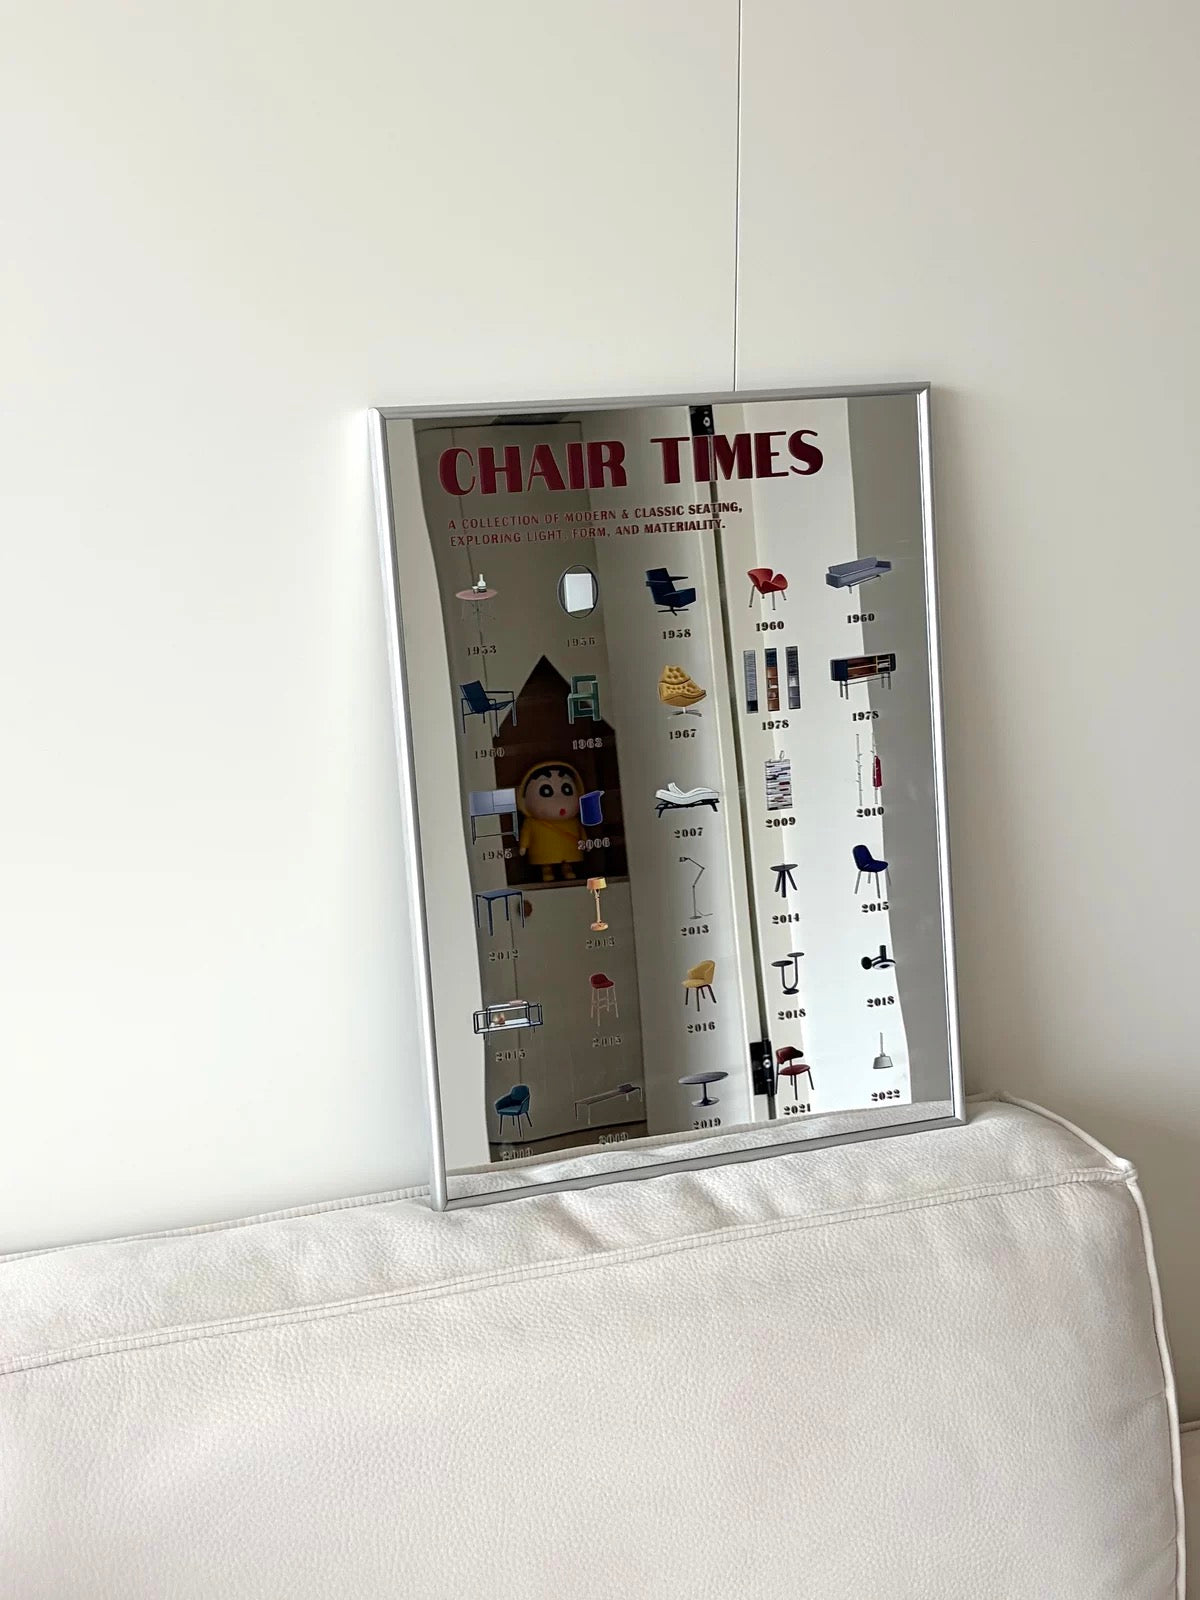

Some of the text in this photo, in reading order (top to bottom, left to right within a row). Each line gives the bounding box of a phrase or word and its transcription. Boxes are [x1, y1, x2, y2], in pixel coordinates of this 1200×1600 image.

[438, 429, 824, 496] CHAIR TIMES
[448, 501, 743, 530] A COLLECTION OF MODERN & CLASSIC SEATING,
[450, 532, 521, 547] EXPLORING
[615, 524, 640, 536] AND
[644, 519, 726, 534] MATERIALITY.
[847, 613, 875, 623] 1960
[756, 621, 784, 631] 1960
[662, 629, 691, 639] 1958
[467, 644, 497, 656] 1953
[852, 711, 879, 721] 1978
[762, 719, 789, 730] 1978
[669, 729, 696, 740] 1967
[572, 738, 602, 750] 1963
[856, 807, 884, 817] 2010
[766, 817, 796, 828] 2009
[674, 828, 703, 838] 2007
[862, 902, 889, 913] 2015
[772, 914, 800, 924] 2014
[681, 925, 709, 936] 2013
[489, 950, 520, 962] 2012
[867, 996, 895, 1007] 2018
[778, 1008, 806, 1020] 2018
[687, 1022, 715, 1033] 2016
[496, 1049, 526, 1062] 2015
[872, 1090, 900, 1101] 2022
[784, 1104, 811, 1115] 2021
[693, 1118, 721, 1129] 2019
